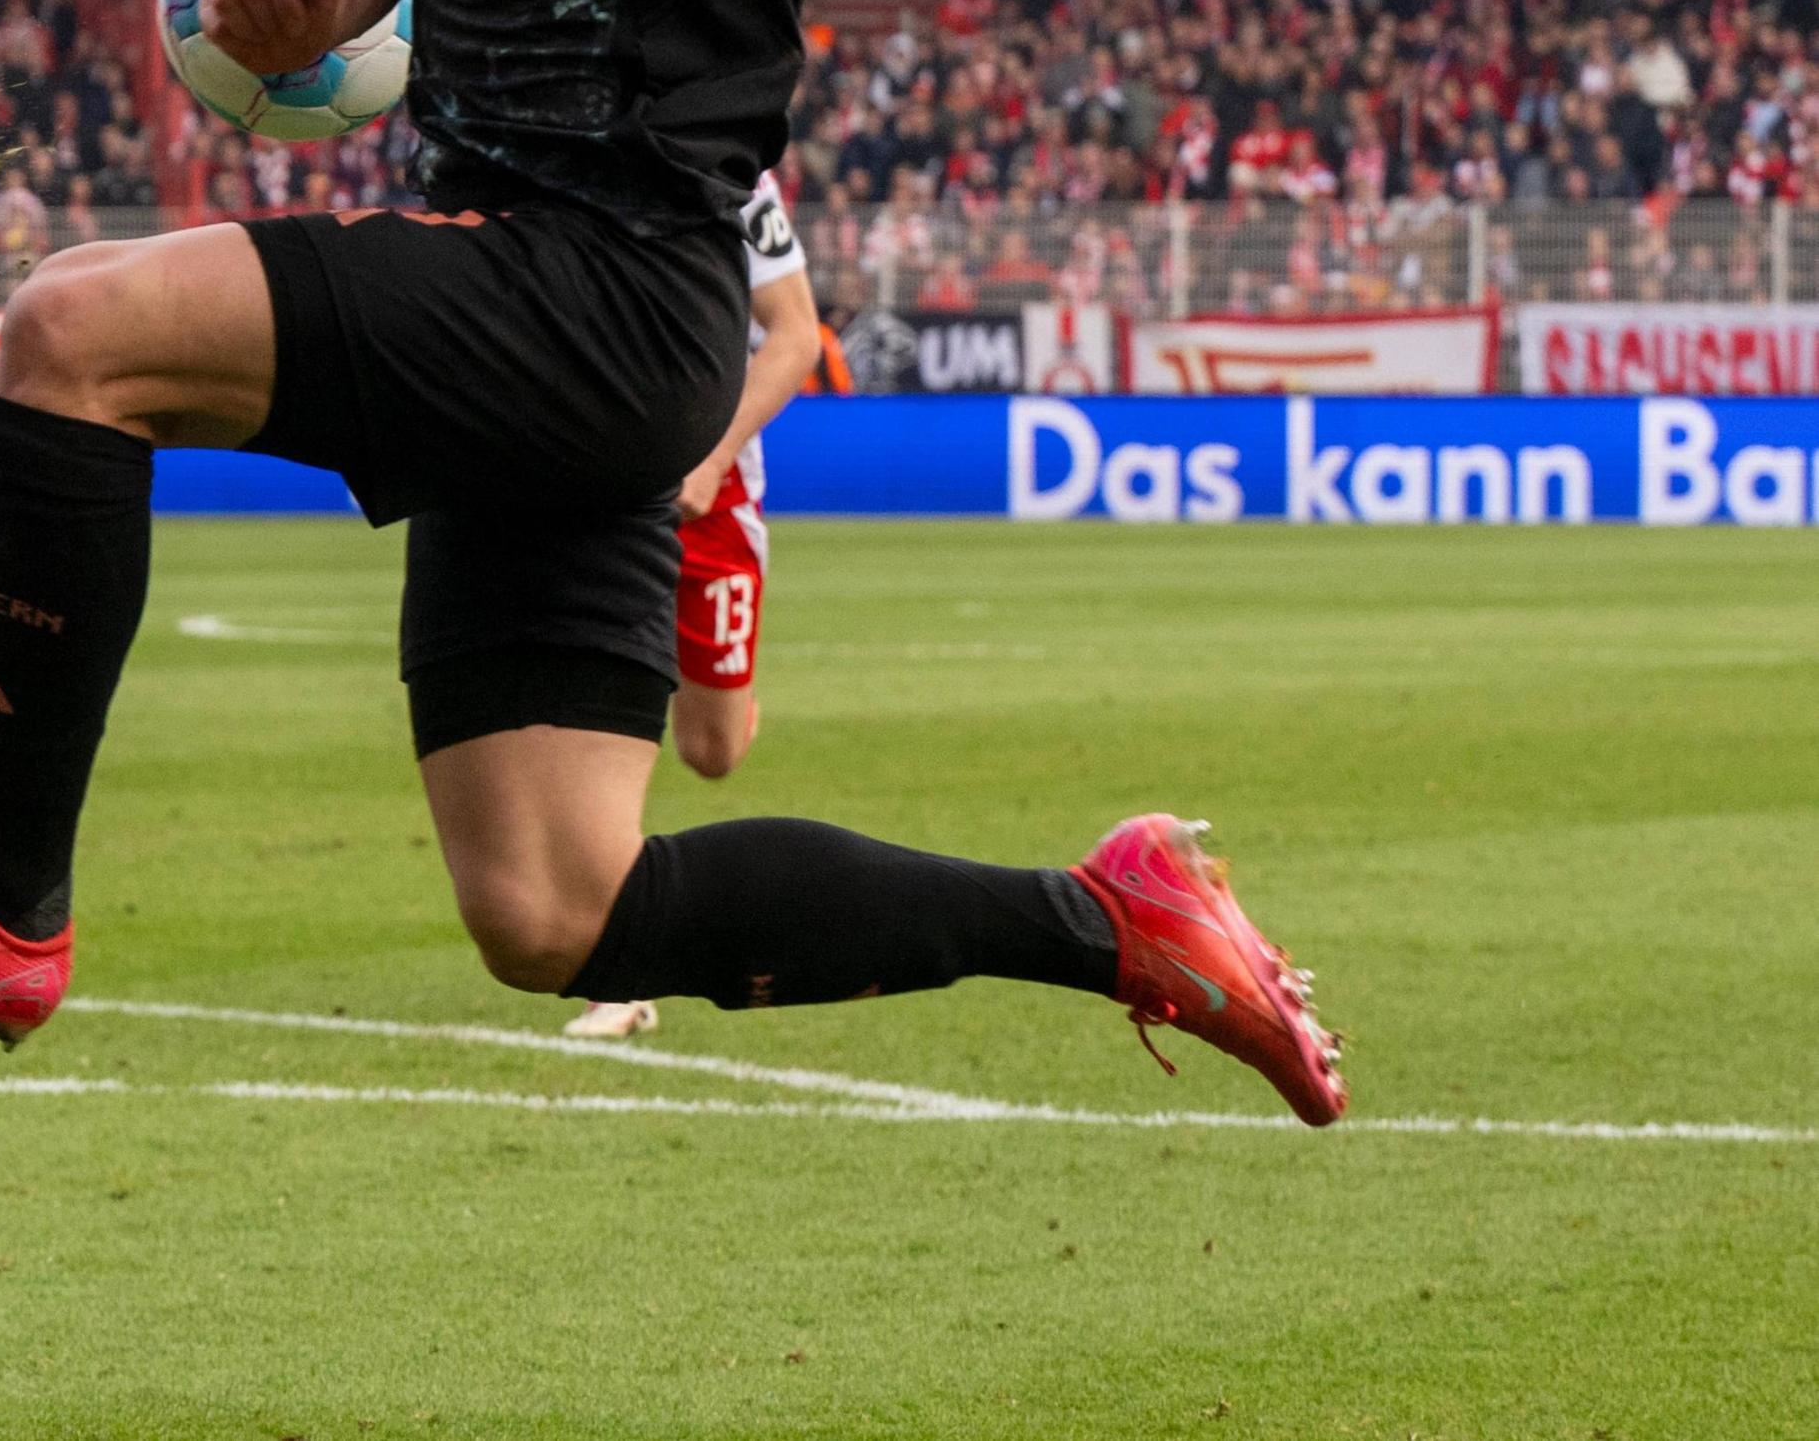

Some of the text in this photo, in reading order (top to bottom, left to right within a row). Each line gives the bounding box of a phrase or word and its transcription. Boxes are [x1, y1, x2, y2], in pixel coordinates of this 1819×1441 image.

[1008, 395, 1819, 525] Das kann Ba
[704, 573, 754, 647] 13
